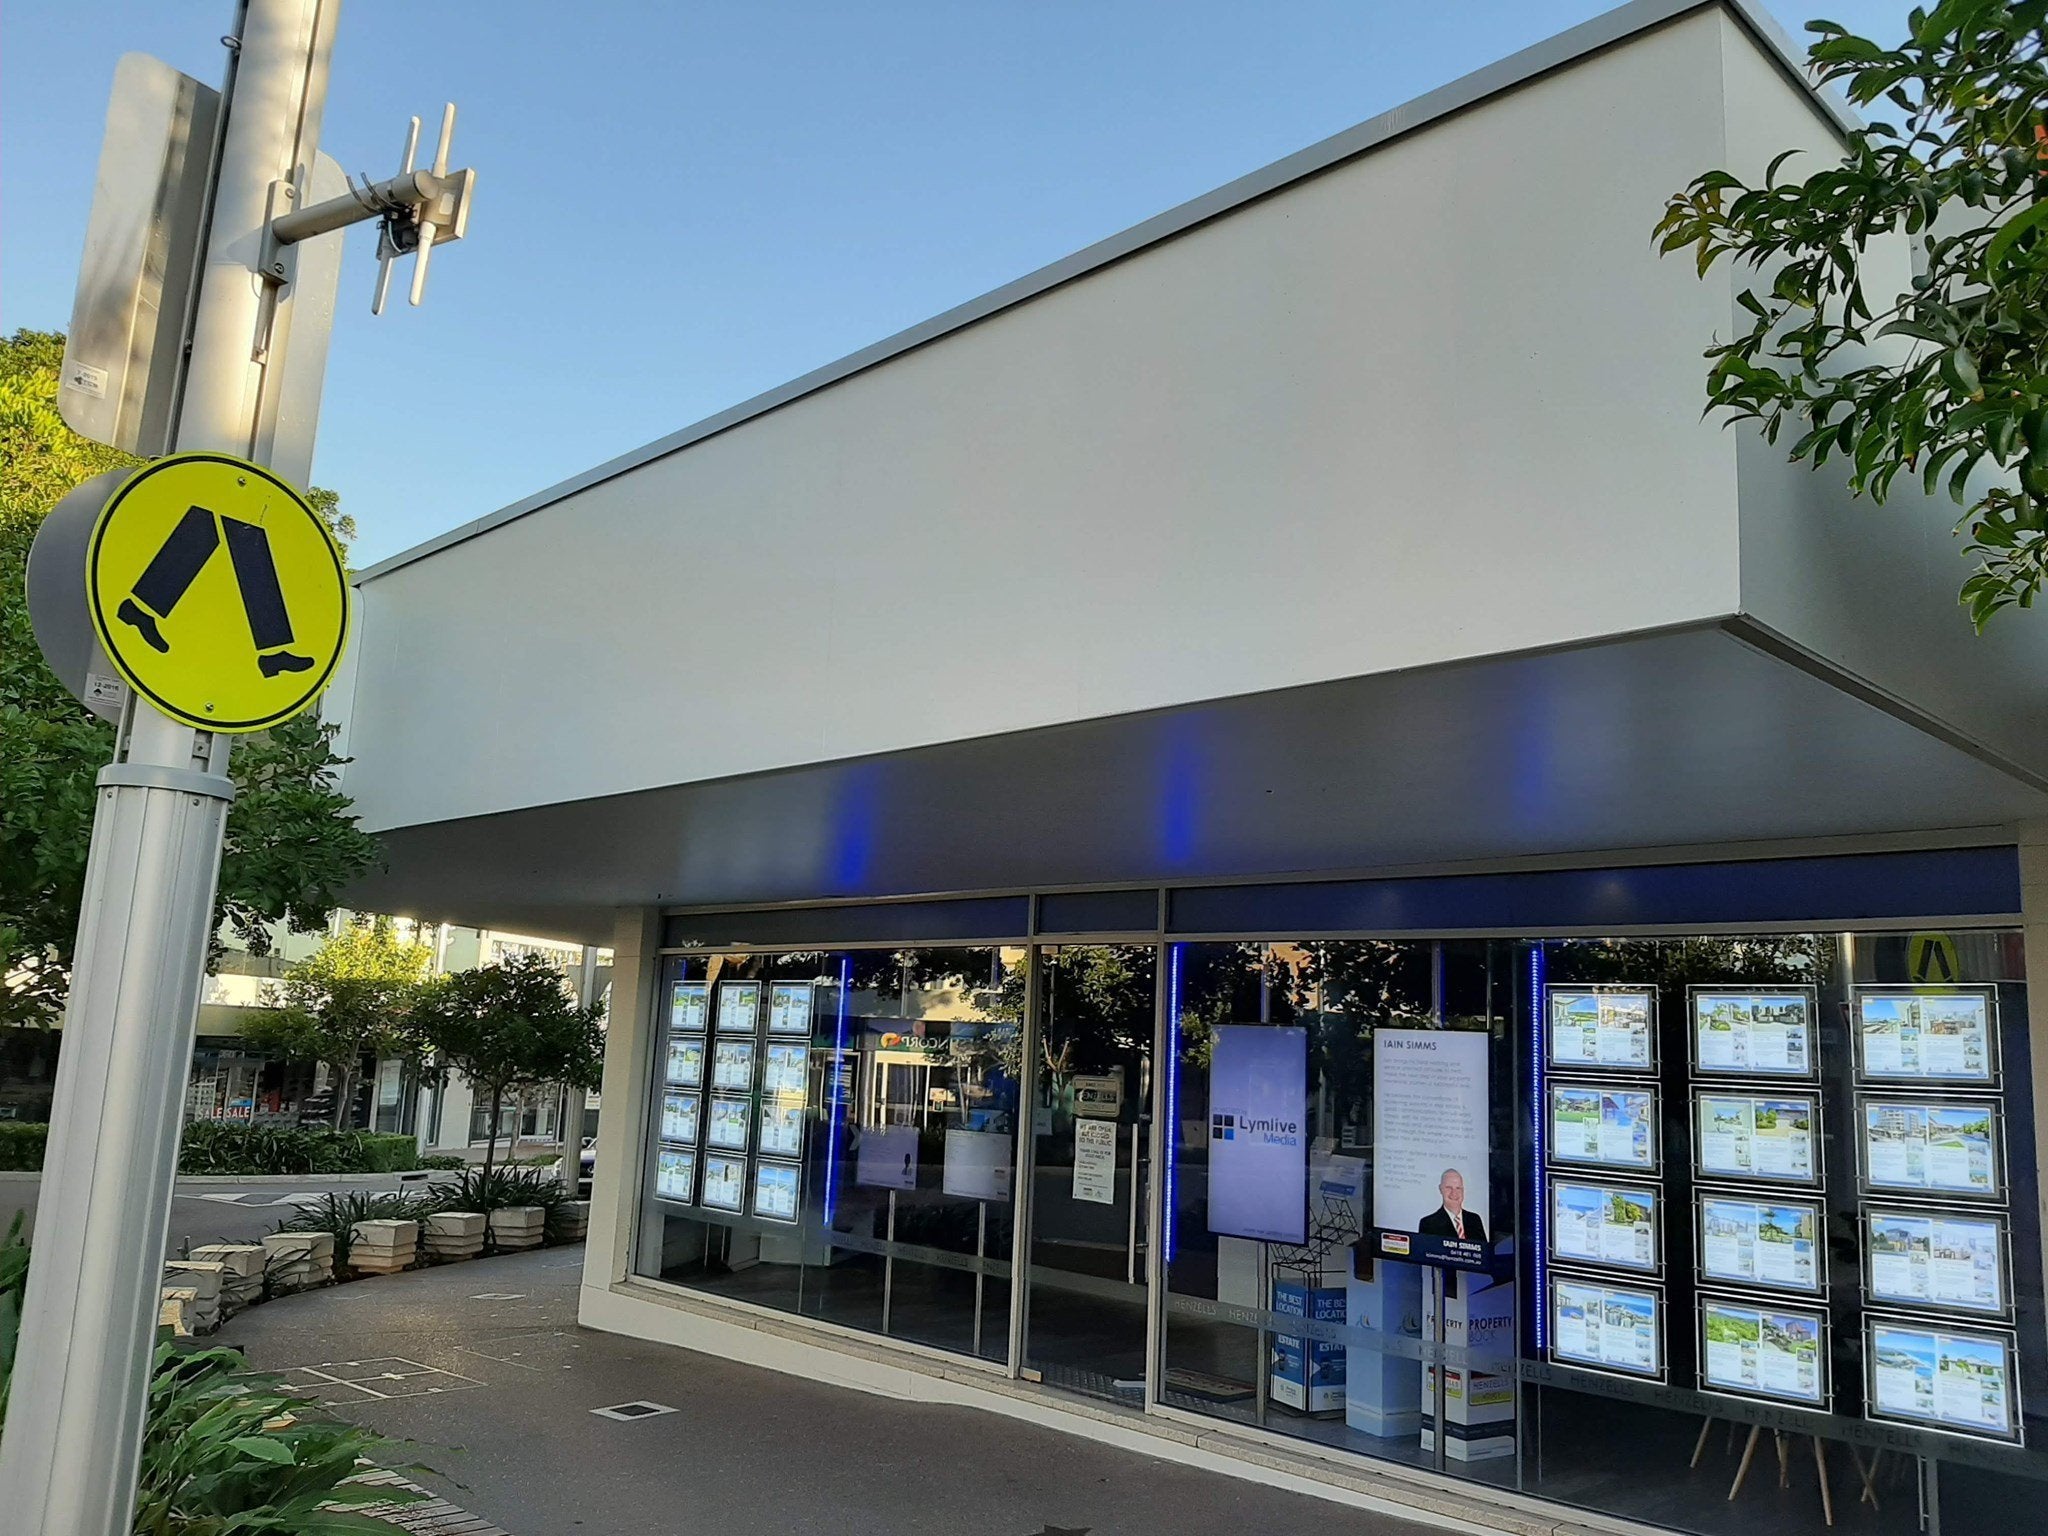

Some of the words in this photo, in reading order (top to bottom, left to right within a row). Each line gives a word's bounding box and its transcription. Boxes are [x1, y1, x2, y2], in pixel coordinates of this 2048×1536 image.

[1383, 1039, 1404, 1050] IAIN
[1406, 1040, 1438, 1051] SIMMS
[197, 1107, 223, 1120] SALE
[225, 1106, 251, 1119] SALE
[1239, 1115, 1297, 1134] Lymlive
[1263, 1132, 1297, 1146] Media
[1317, 1299, 1332, 1308] THE
[1469, 1315, 1513, 1331] PROPERTY
